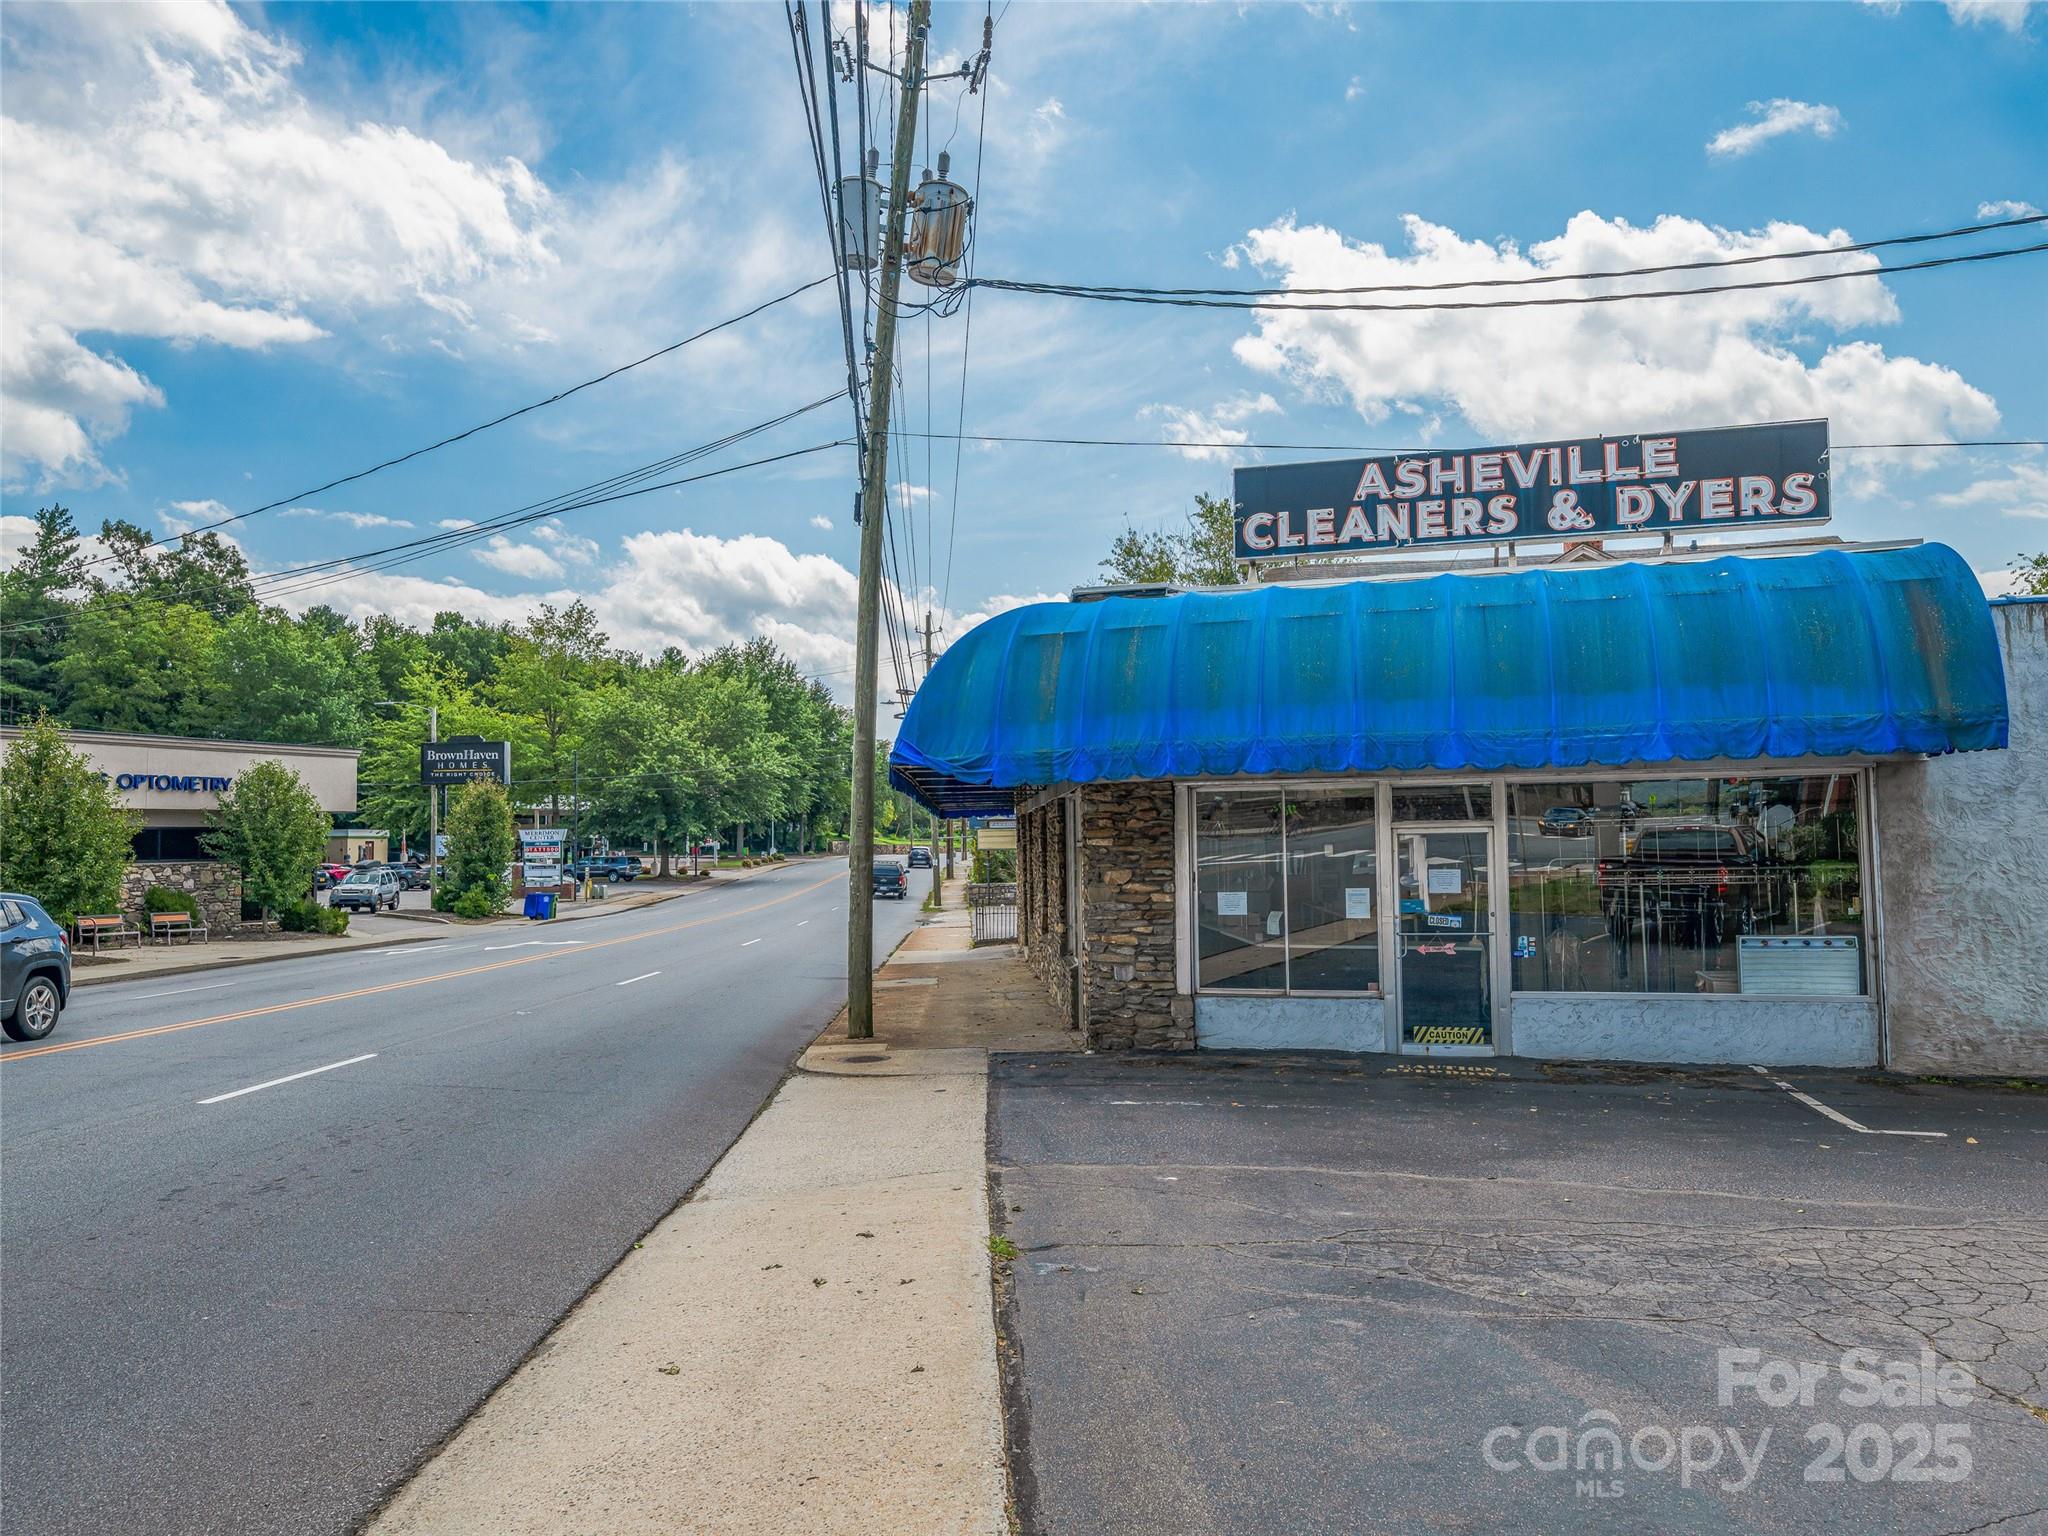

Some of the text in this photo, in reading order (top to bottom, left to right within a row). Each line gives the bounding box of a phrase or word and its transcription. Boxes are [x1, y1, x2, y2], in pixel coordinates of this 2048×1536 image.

[1352, 436, 1679, 501] ASHEVILLE
[1242, 473, 1818, 550] CLEANERS & DYERS
[427, 749, 499, 761] BrownHaven
[437, 761, 488, 769] HOMES
[116, 773, 232, 792] OPTOMETRY
[1429, 916, 1450, 925] CLOSED
[1429, 1031, 1468, 1040] CAUTION
